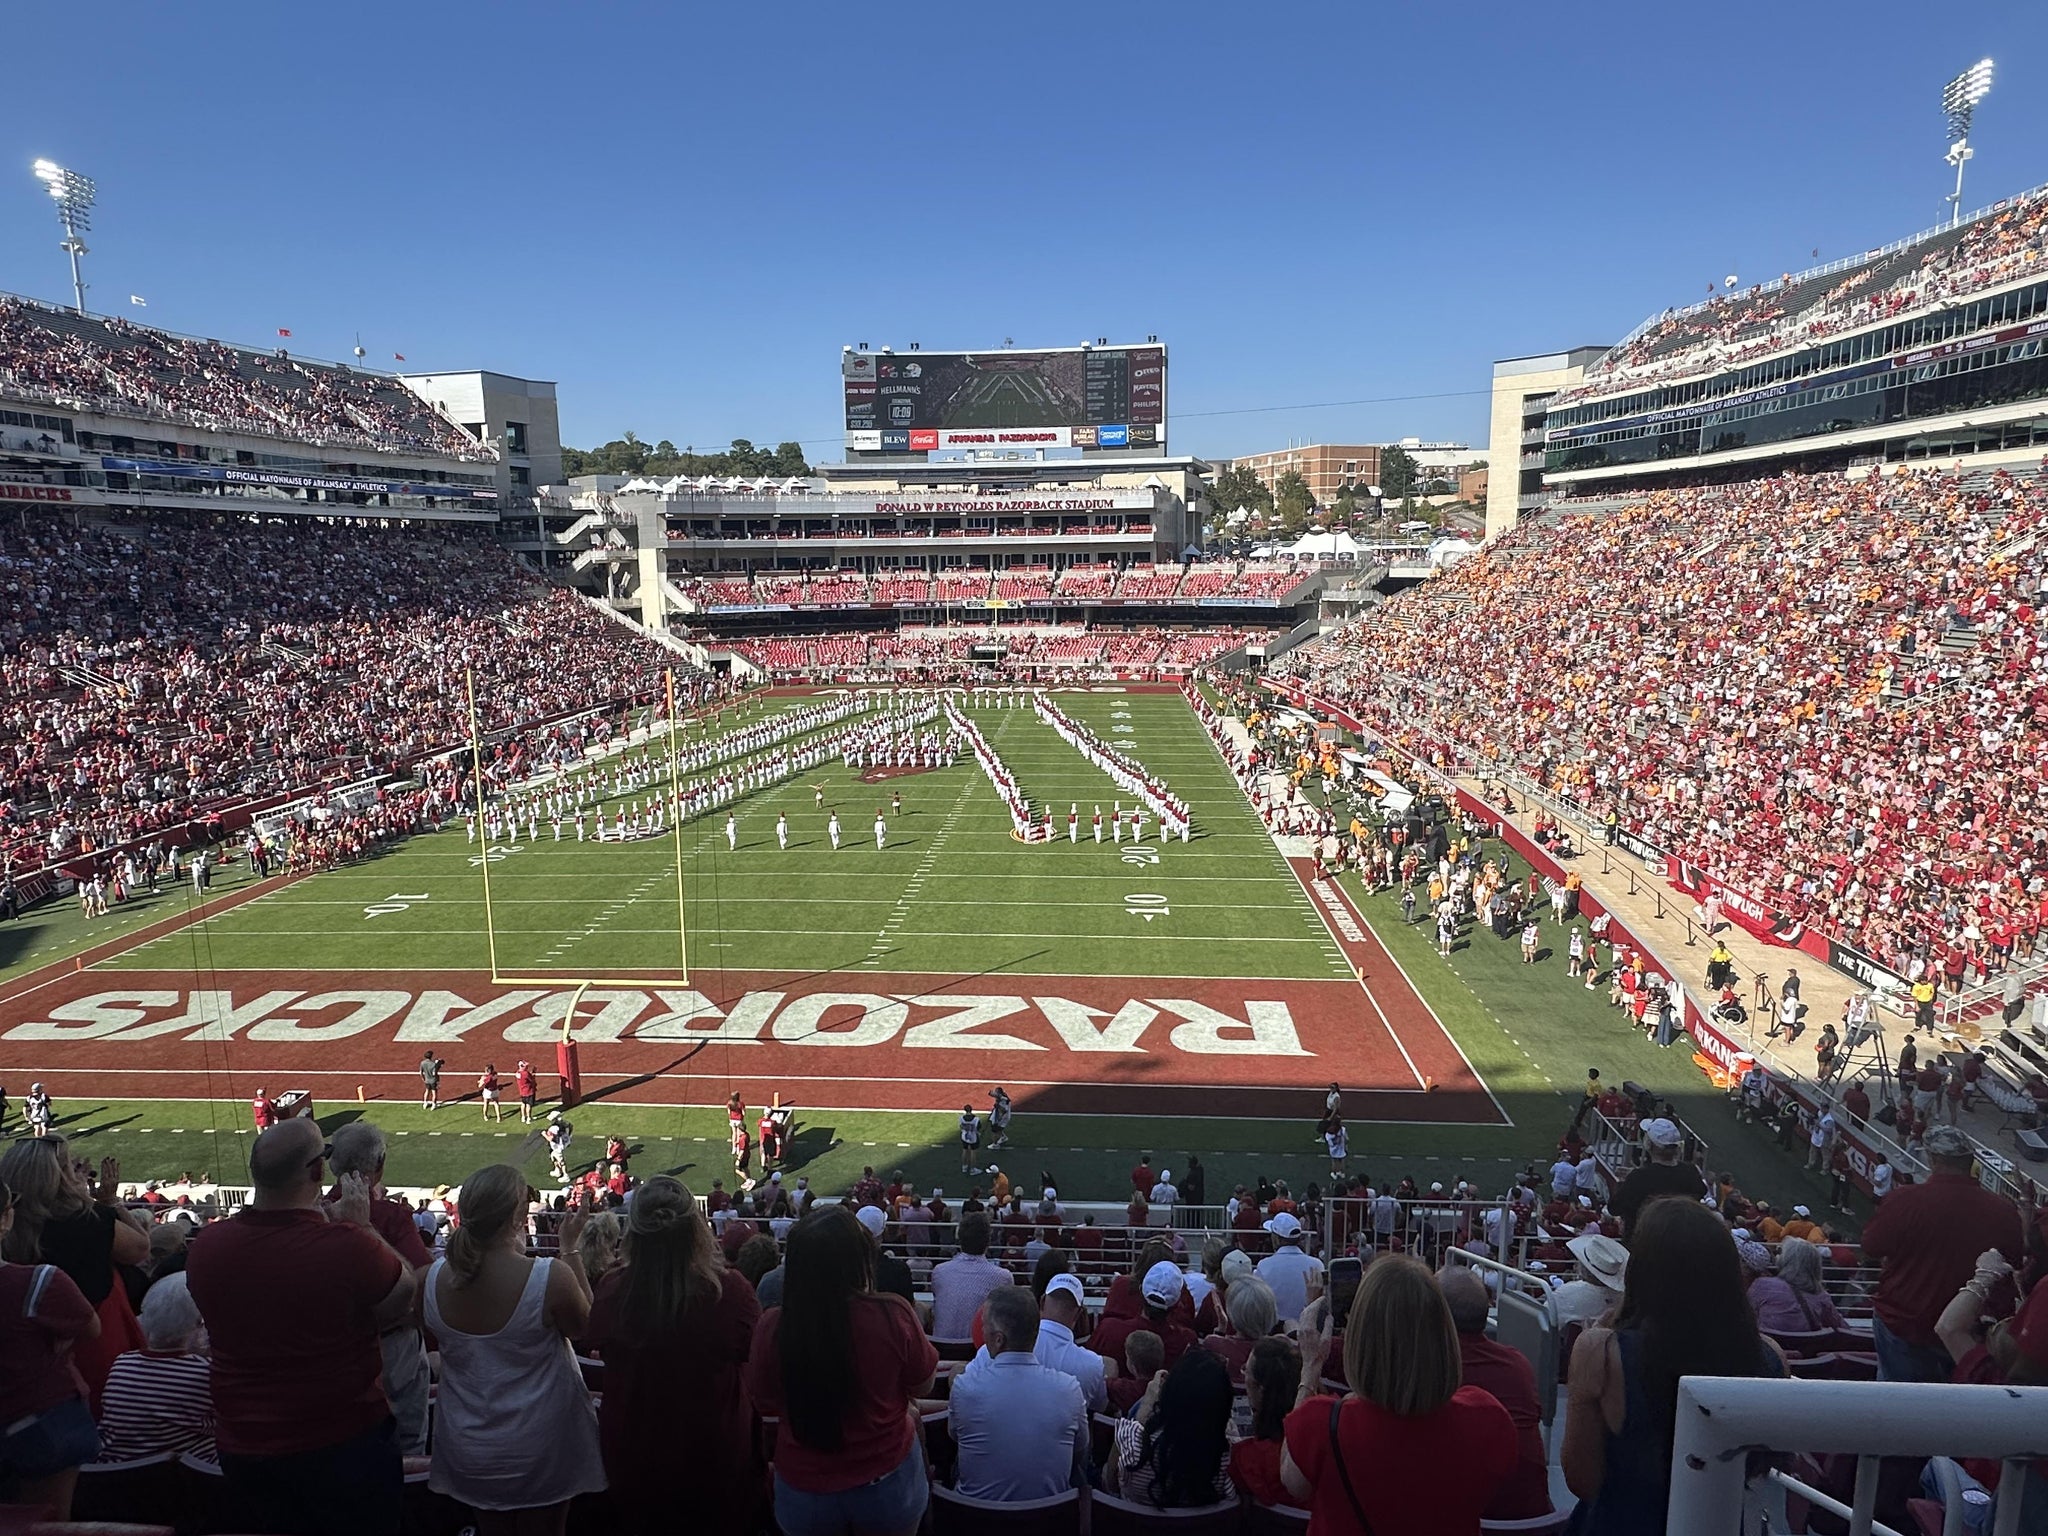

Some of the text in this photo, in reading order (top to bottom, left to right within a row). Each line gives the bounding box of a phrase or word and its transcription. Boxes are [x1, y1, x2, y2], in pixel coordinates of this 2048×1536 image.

[881, 385, 921, 395] HELLMANN'S
[1646, 411, 1675, 423] OFFICIAL
[1676, 404, 1714, 417] MAYONNAISE
[1715, 401, 1722, 410] OF
[1755, 385, 1787, 400] ATHLETICS
[948, 433, 1057, 443] ARKANSAS RAZORBACKS
[226, 470, 258, 481] OFFICIAL
[260, 474, 302, 485] MAYONNAISE
[303, 478, 312, 486] OF
[352, 482, 388, 492] ATHLETICS
[875, 499, 1114, 512] DONALD W REYNOLDS RAZORBACK STADIUM
[1124, 894, 1170, 915] 10
[1837, 951, 1855, 970] THE
[1, 988, 1318, 1056] RAZORBACKS
